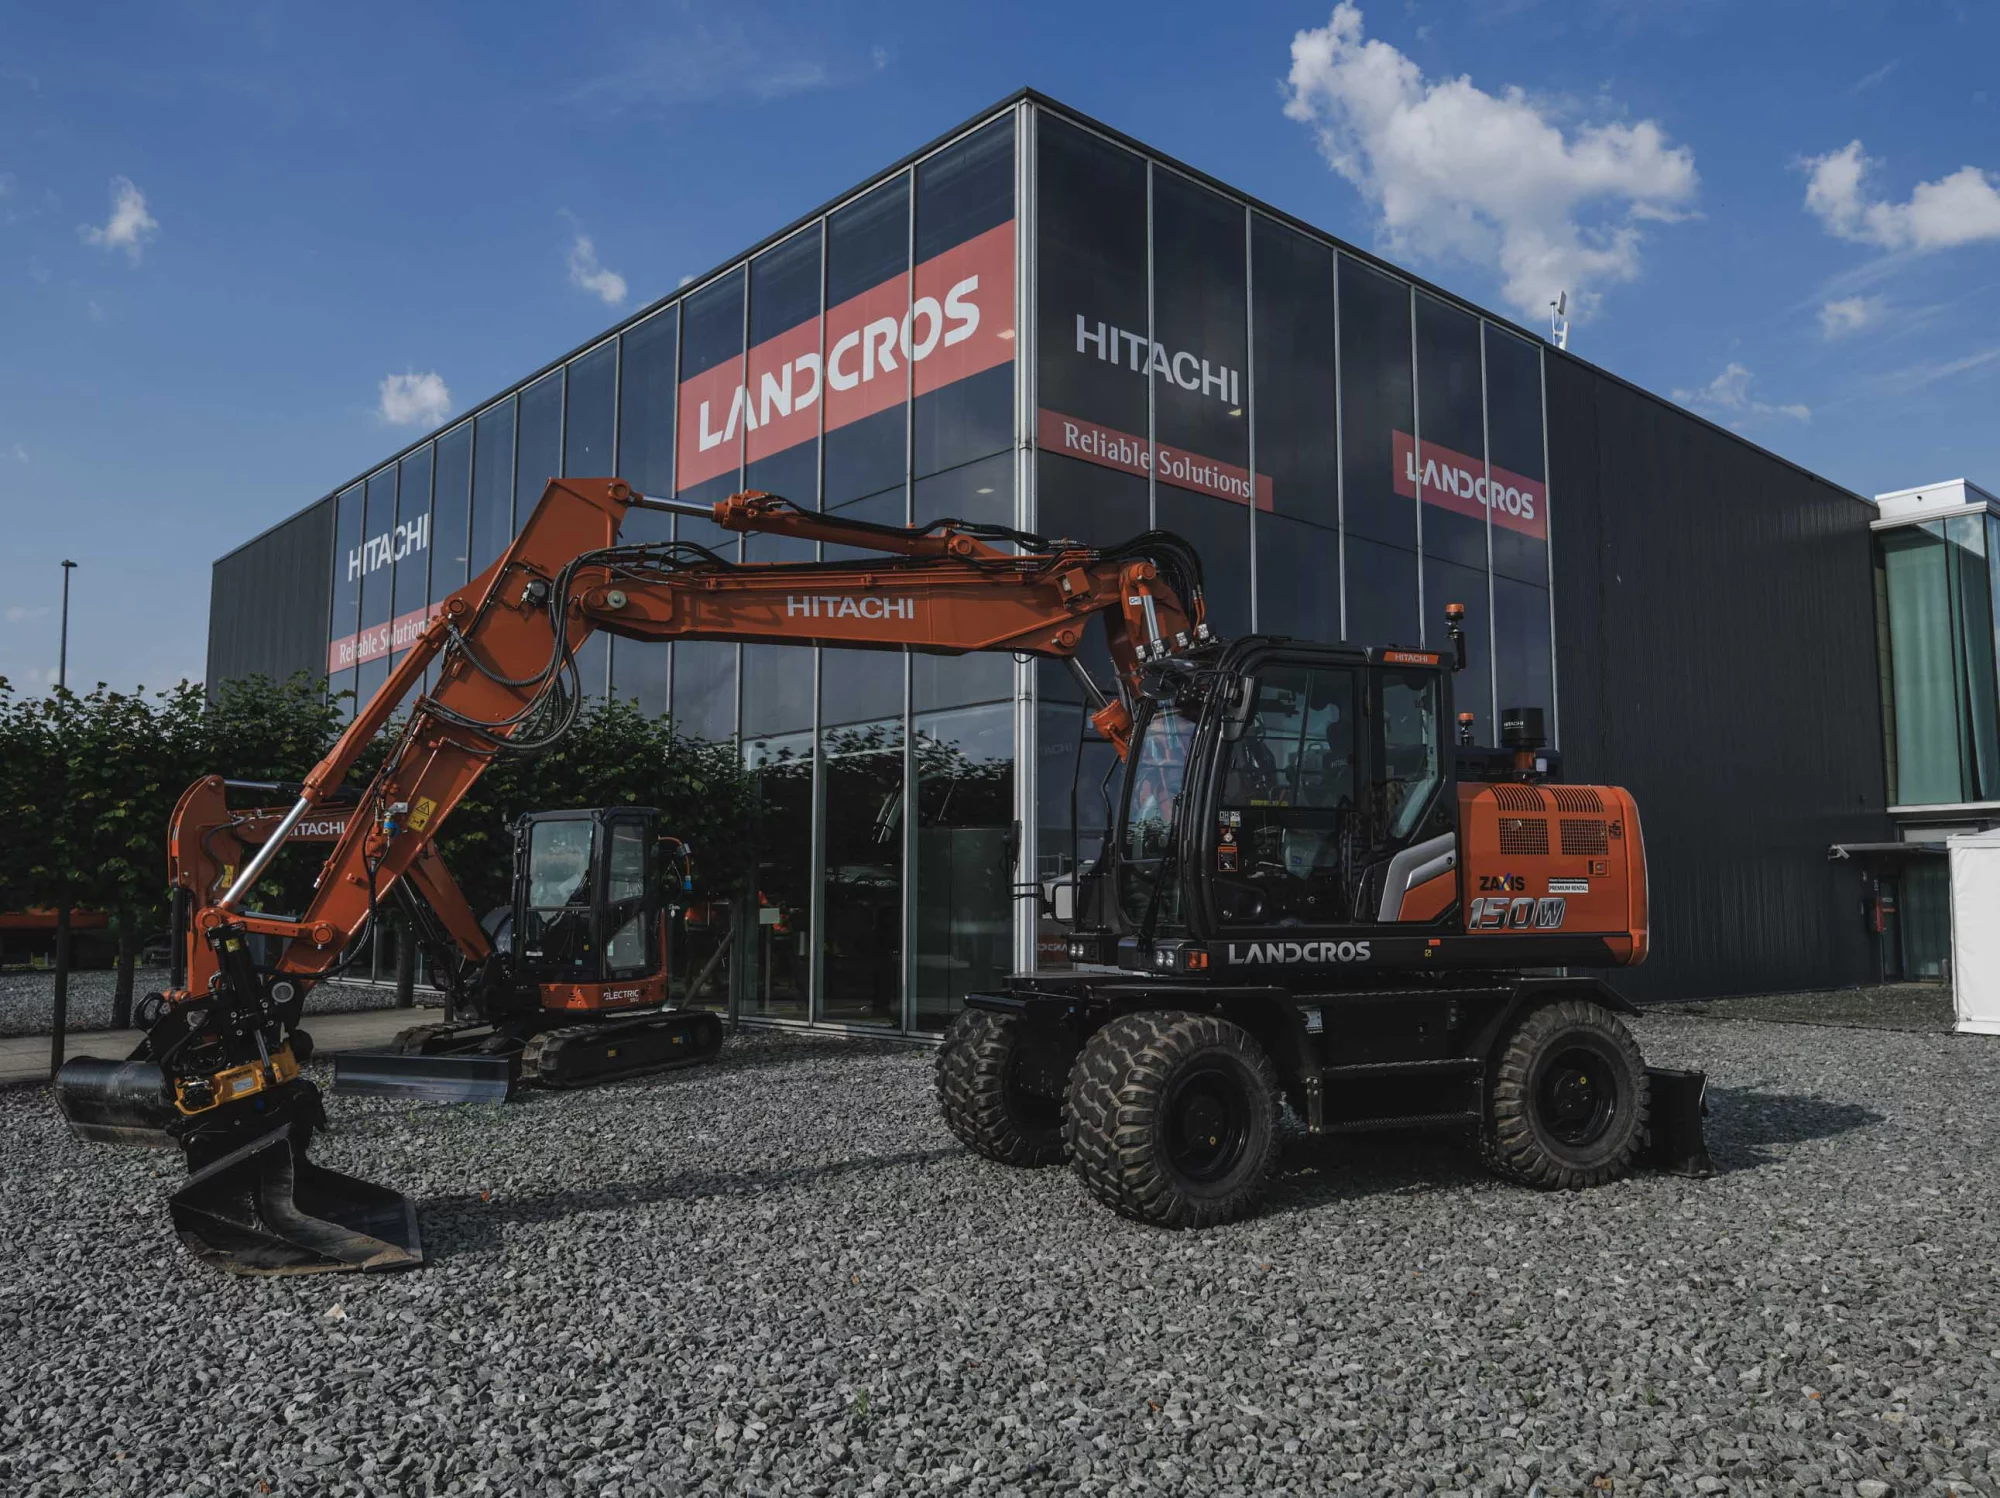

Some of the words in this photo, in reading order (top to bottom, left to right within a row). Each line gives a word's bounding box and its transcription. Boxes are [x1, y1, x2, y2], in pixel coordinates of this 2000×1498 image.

[699, 274, 981, 452] LANDCROS
[1076, 314, 1238, 406] HITACHI
[1063, 421, 1150, 470] Reliable
[1159, 450, 1250, 498] Solutions
[1406, 451, 1534, 520] LANDCROS
[348, 513, 429, 582] HITACHI
[787, 595, 914, 619] HITACHI
[339, 632, 378, 664] Relable
[1394, 653, 1428, 663] HITACHI
[290, 821, 345, 837] ITACHI
[1480, 873, 1525, 891] ZAXIS
[1468, 897, 1567, 930] 150W
[1228, 941, 1371, 965] LANDCROS
